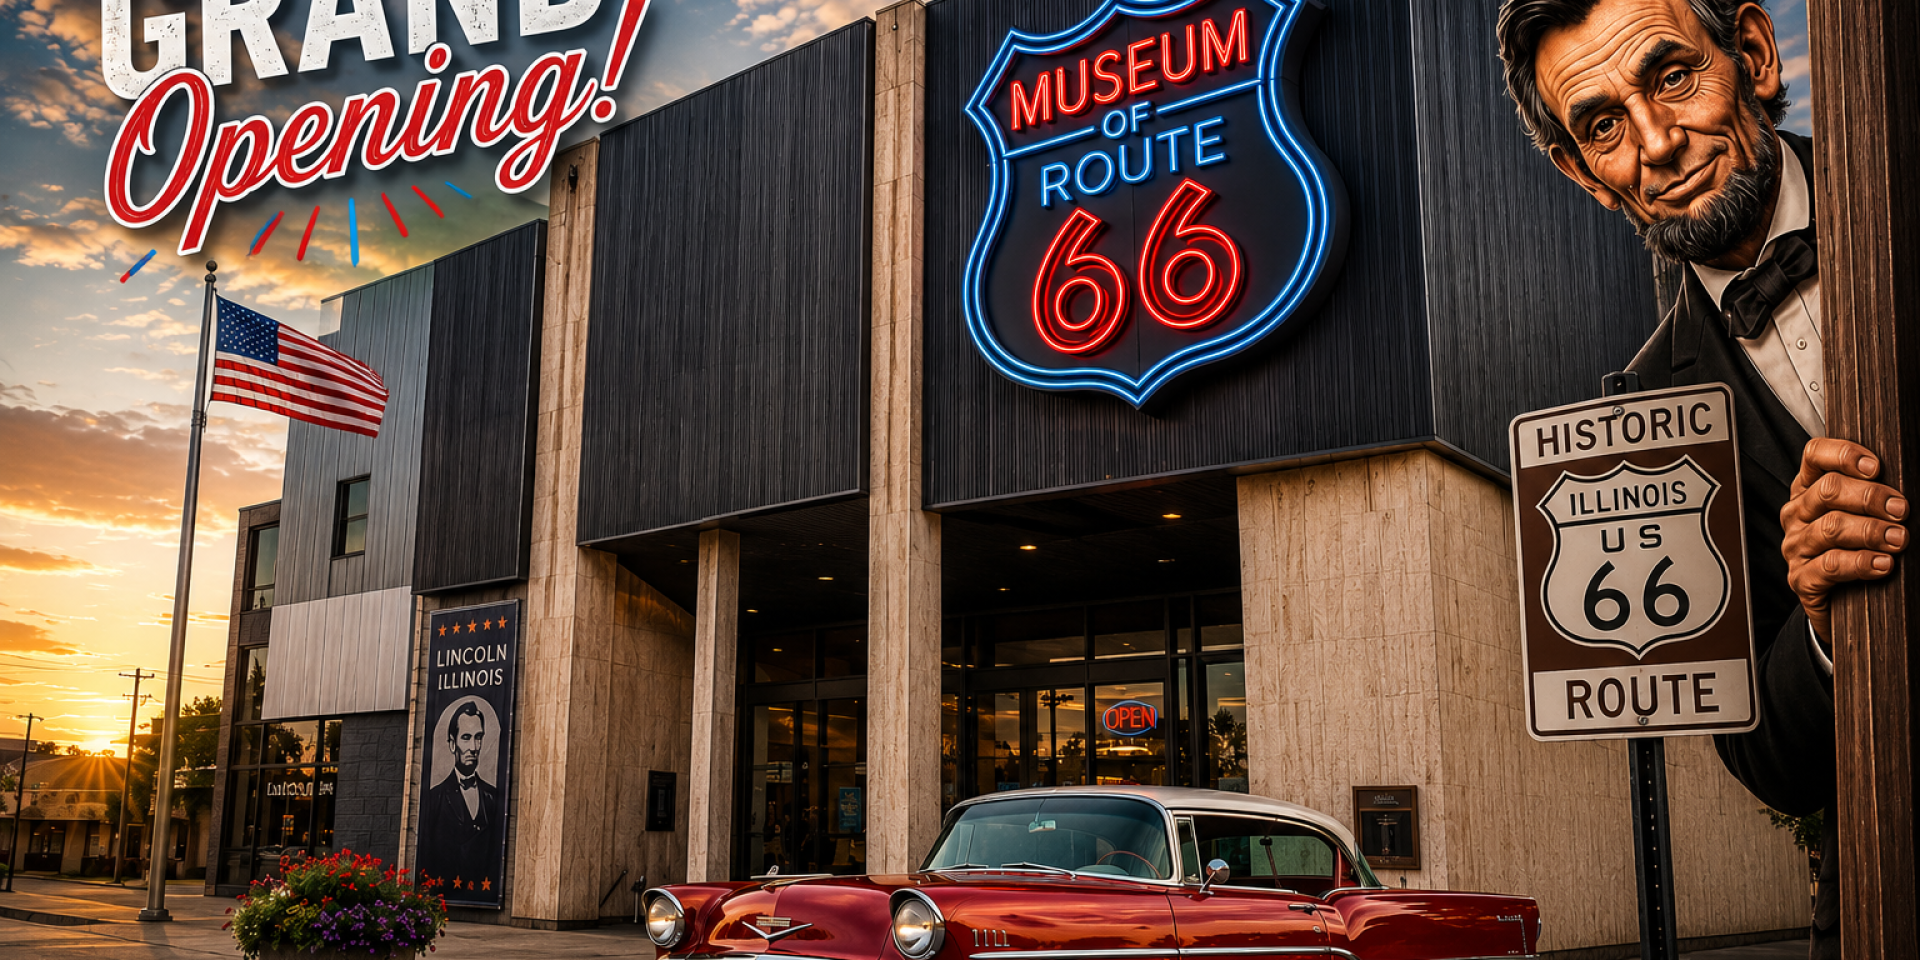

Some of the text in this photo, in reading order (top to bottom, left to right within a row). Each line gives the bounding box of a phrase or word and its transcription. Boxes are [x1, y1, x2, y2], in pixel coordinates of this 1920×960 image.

[1010, 7, 1251, 131] MUSEUM
[1101, 101, 1154, 139] OF
[1041, 115, 1228, 207] ROUTE
[1032, 177, 1241, 355] 66
[1536, 402, 1713, 458] HISTORIC
[1570, 480, 1688, 516] ILLINOIS
[1583, 555, 1690, 632] 66
[436, 643, 508, 668] LINCOLN
[438, 668, 504, 690] ILLINOIS
[1105, 706, 1155, 729] OPEN
[1566, 671, 1720, 720] ROUTE
